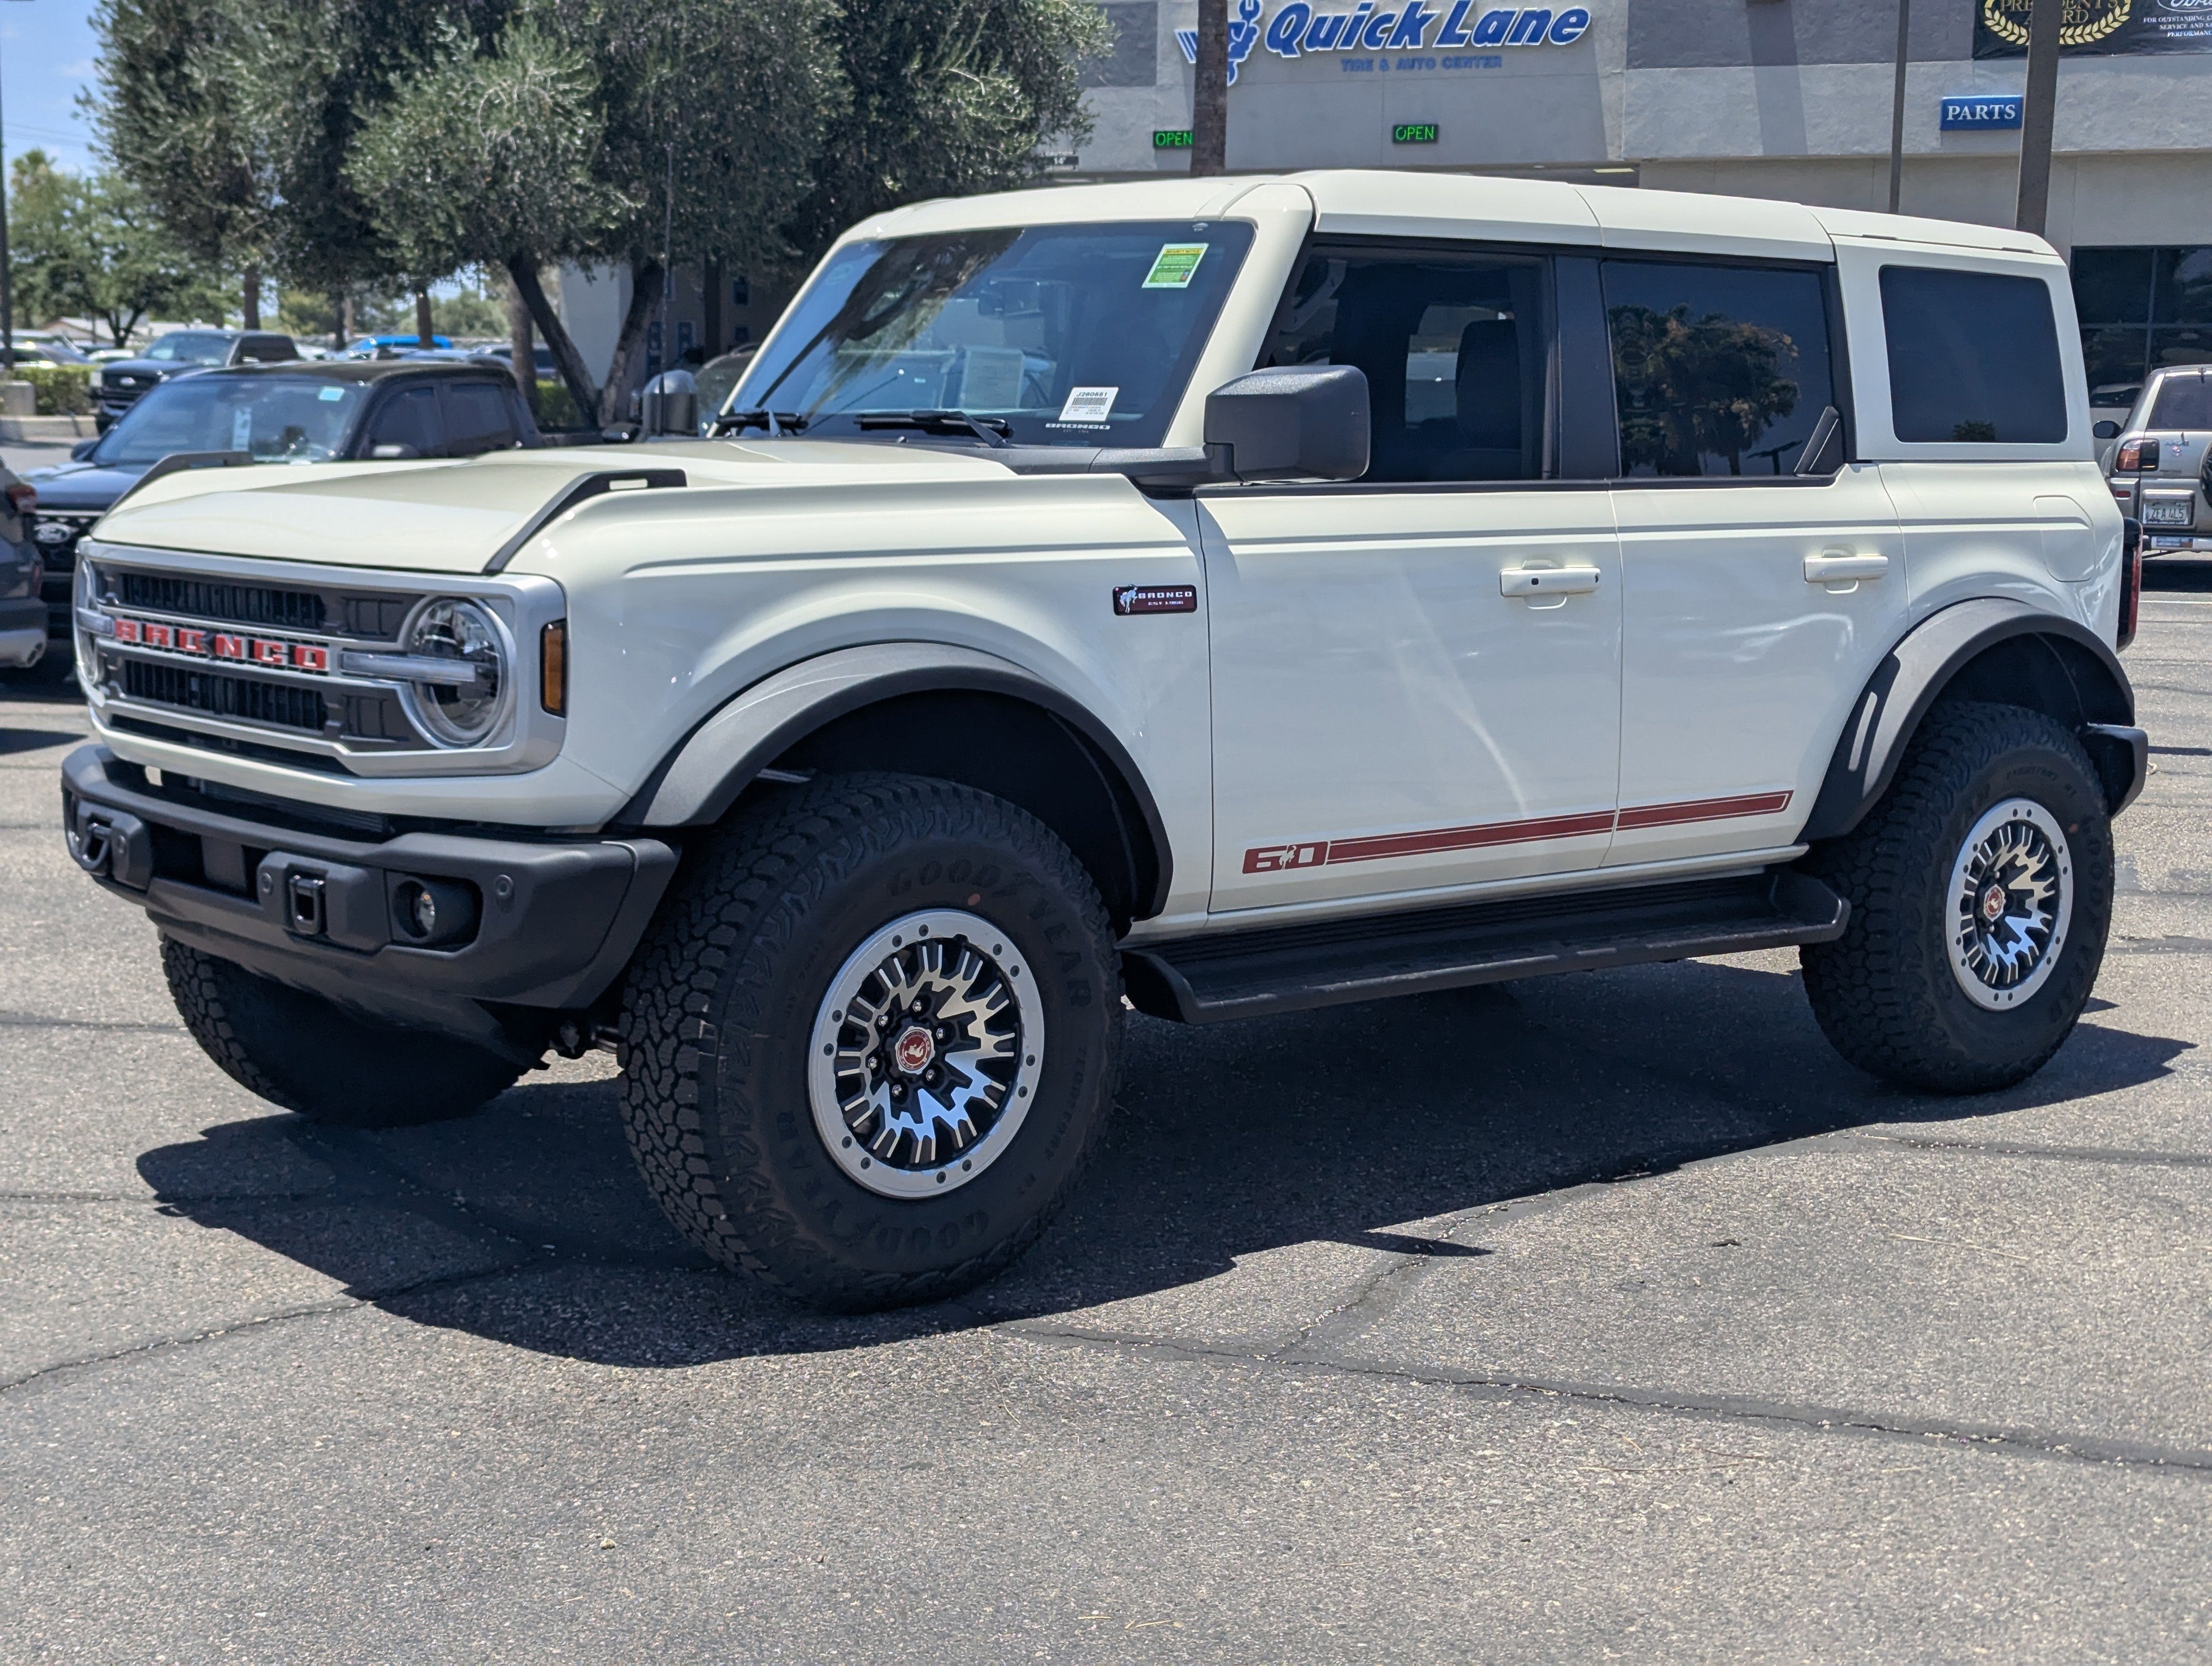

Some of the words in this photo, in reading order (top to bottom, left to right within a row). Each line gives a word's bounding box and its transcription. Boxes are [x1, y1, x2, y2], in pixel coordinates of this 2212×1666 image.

[1265, 0, 1441, 57] Quick
[1432, 0, 1591, 48] Lane
[1341, 57, 1374, 72] TIRE
[1379, 57, 1389, 71] &
[1396, 56, 1436, 70] AUTO
[1442, 55, 1502, 69] CENTER
[1946, 104, 2016, 120] PARTS
[1155, 131, 1193, 146] OPEN
[1395, 125, 1435, 140] OPEN
[115, 619, 330, 671] BRONCO
[1242, 841, 1328, 874] 60
